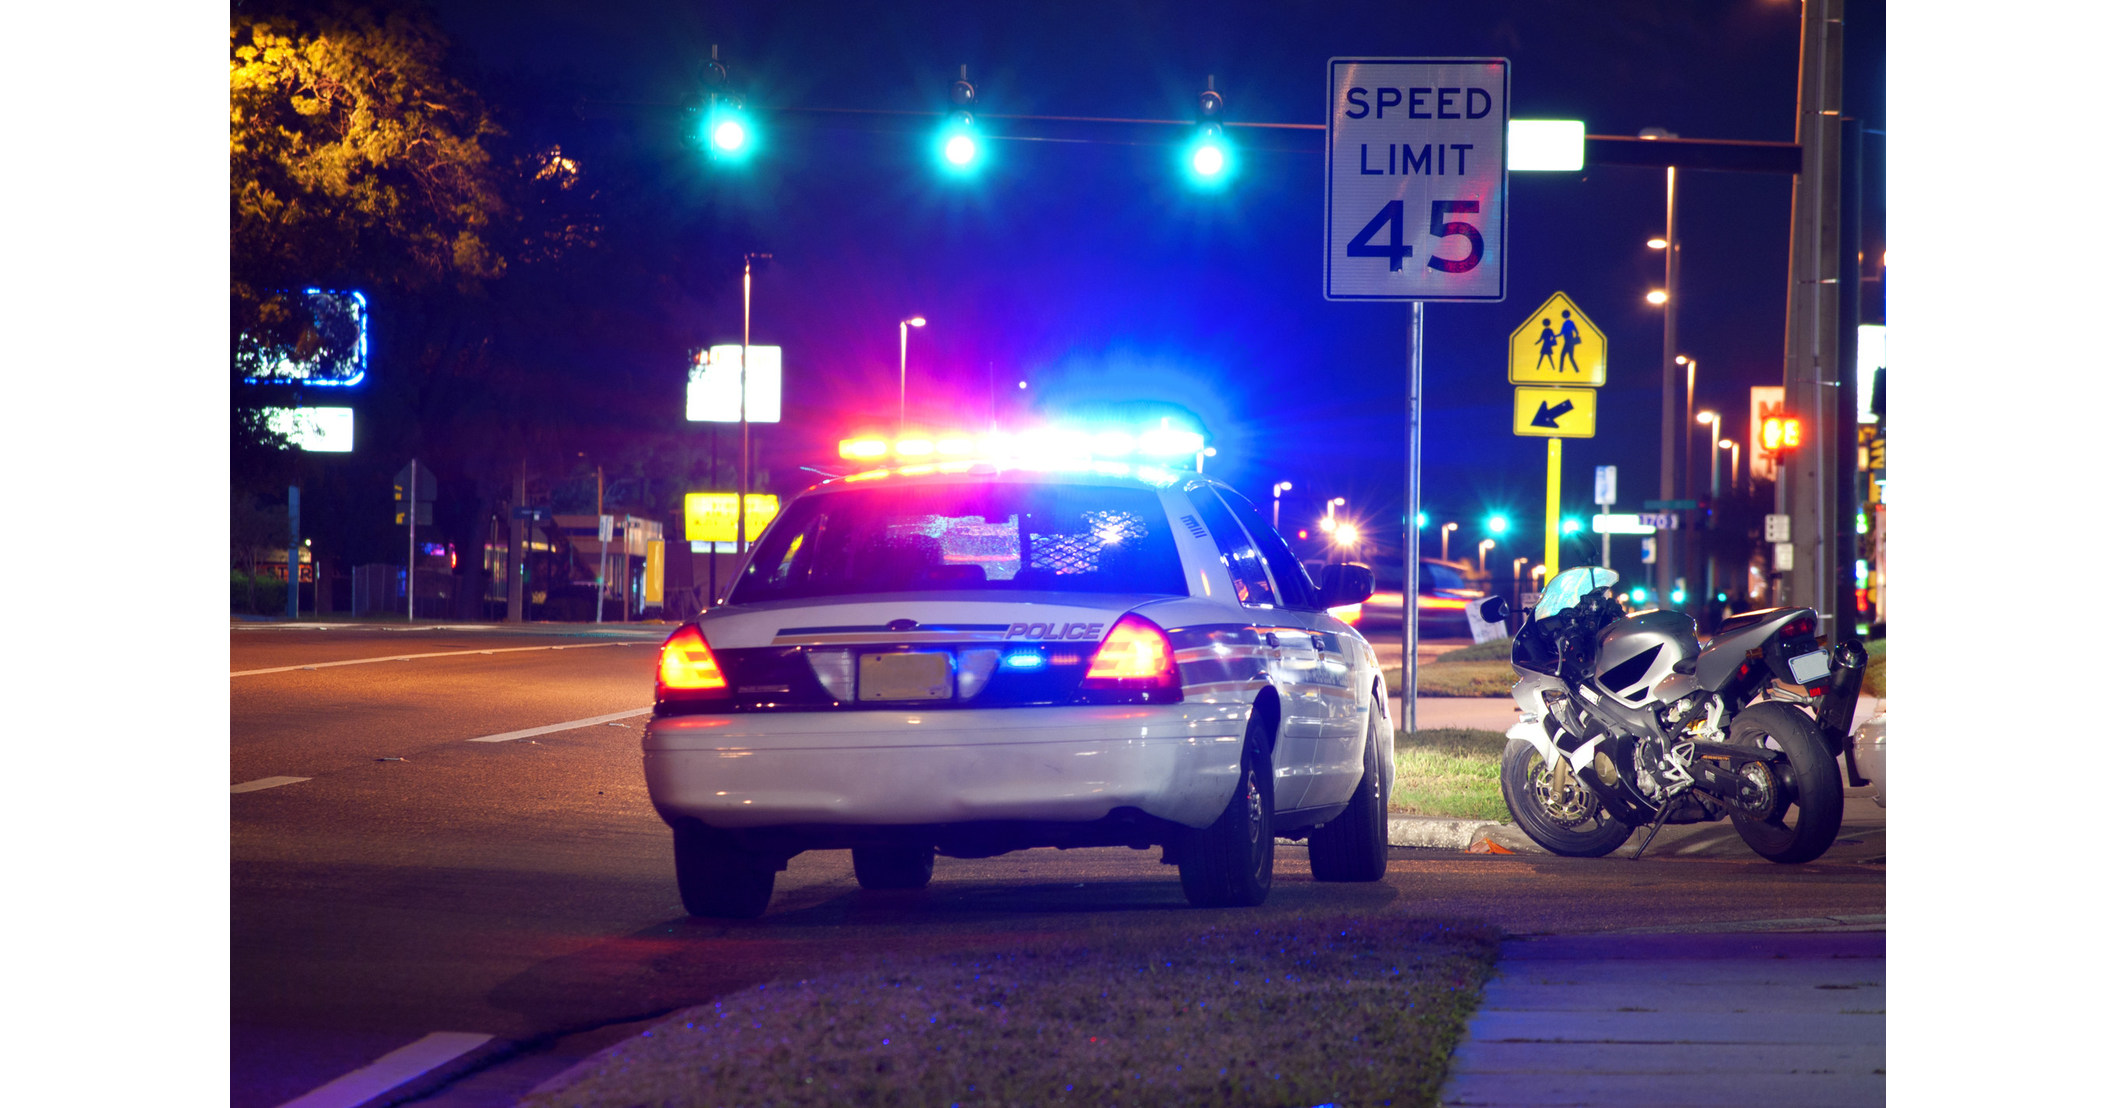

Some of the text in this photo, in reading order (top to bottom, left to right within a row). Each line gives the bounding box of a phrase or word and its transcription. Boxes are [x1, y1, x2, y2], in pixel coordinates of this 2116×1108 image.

[1345, 86, 1492, 120] SPEED
[1360, 143, 1474, 176] LIMIT
[1346, 199, 1485, 274] 45
[1005, 622, 1104, 640] POLICE
